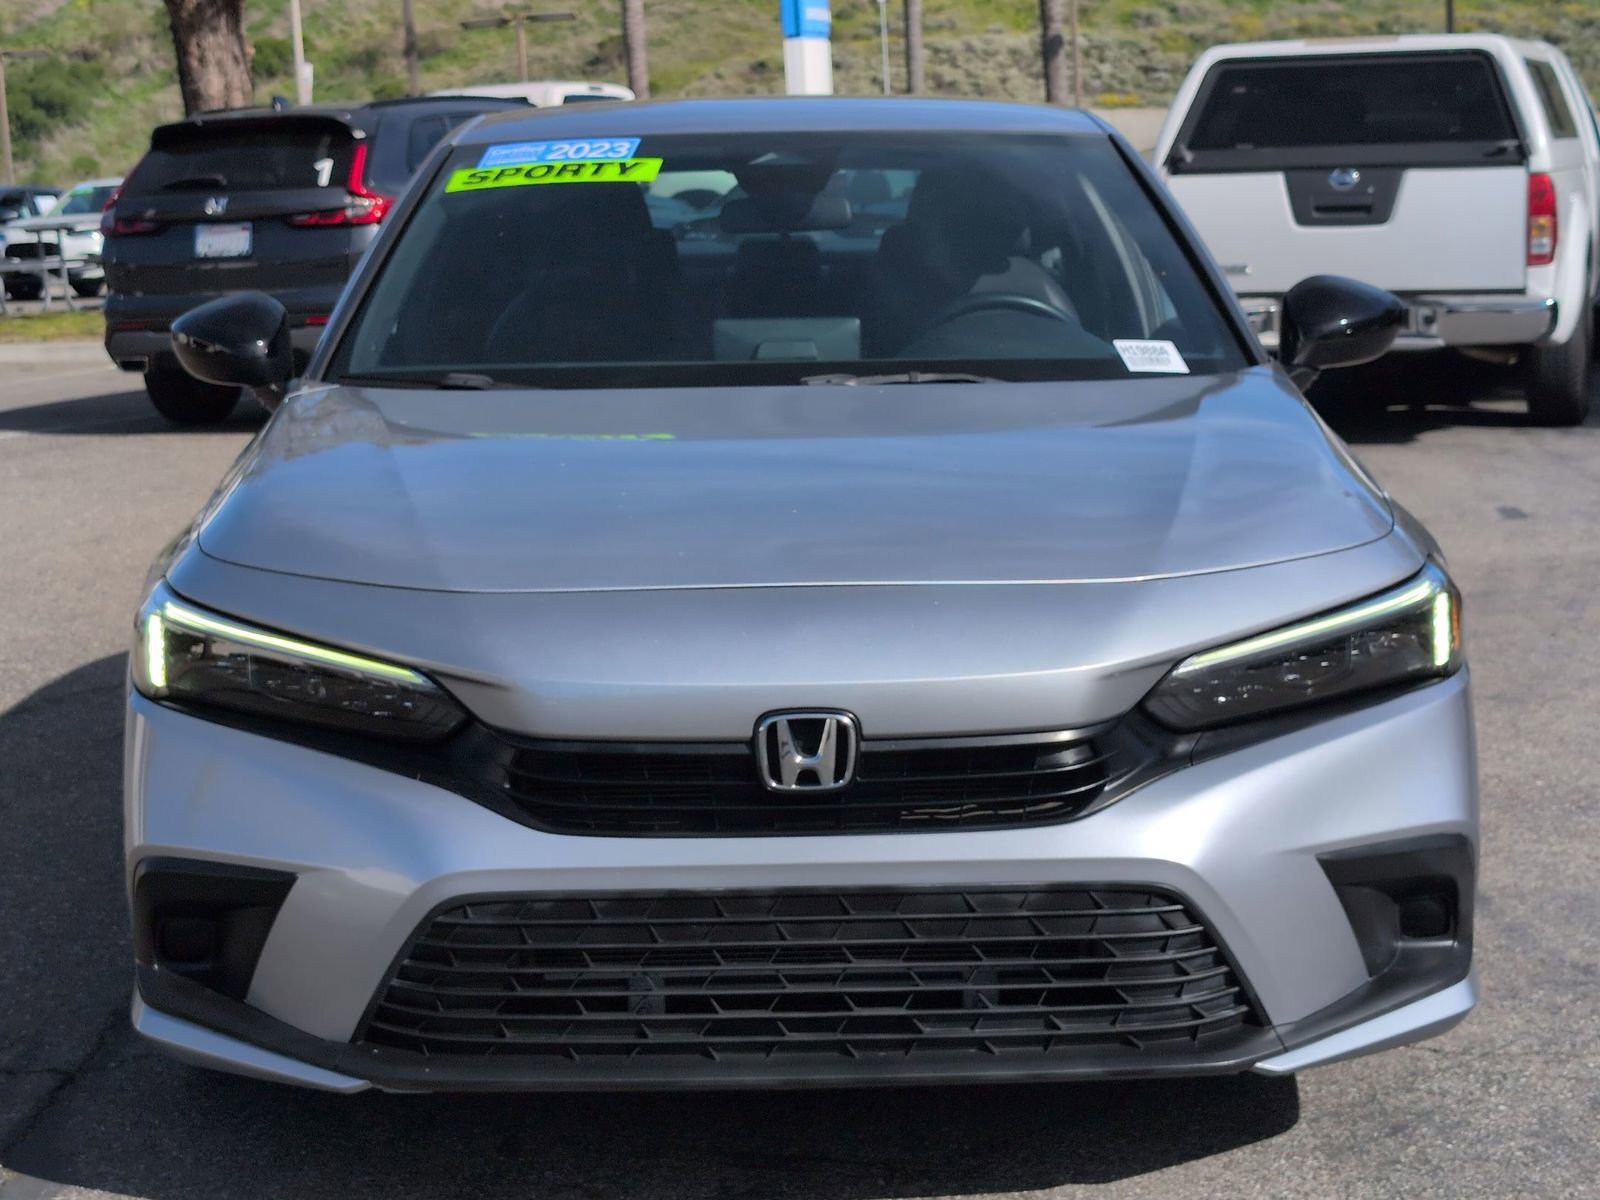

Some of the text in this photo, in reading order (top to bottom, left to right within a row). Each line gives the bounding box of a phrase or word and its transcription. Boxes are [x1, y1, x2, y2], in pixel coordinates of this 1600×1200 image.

[546, 141, 632, 160] 2023
[313, 157, 335, 187] 1
[462, 161, 645, 185] SPORTY
